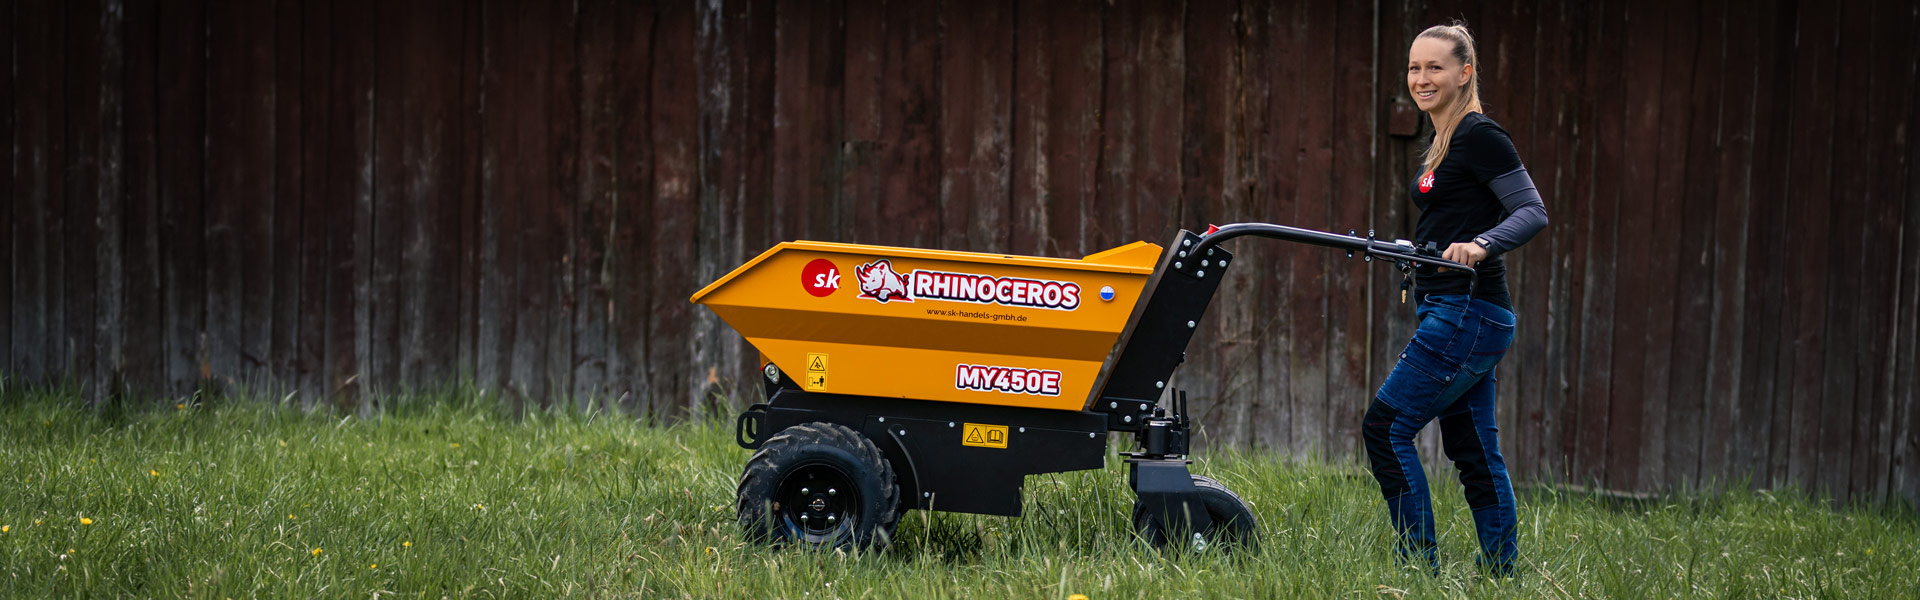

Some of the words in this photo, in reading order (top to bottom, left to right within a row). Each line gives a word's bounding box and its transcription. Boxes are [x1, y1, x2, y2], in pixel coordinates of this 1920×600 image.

[915, 271, 1079, 309] RHINOCEROS
[926, 307, 1028, 323] www.sk-handels-gmbh.de
[957, 365, 1060, 395] MY450E
